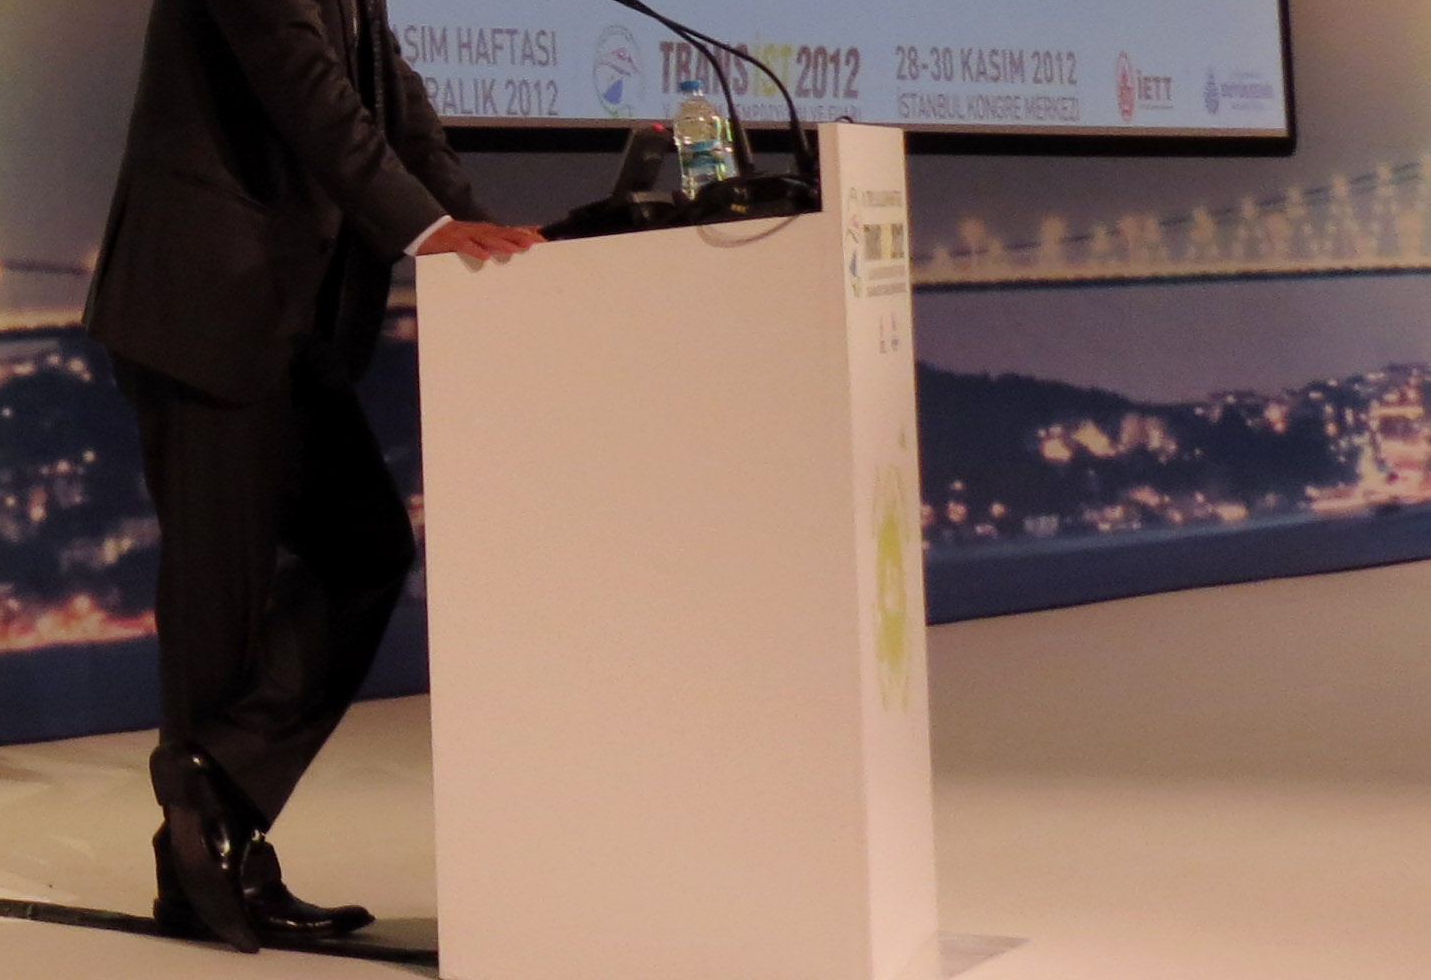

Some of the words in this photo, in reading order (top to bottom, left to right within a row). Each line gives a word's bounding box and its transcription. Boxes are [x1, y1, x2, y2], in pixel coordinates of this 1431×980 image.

[457, 26, 558, 67] HAFTASI
[895, 45, 955, 82] 28-30
[961, 48, 1025, 84] KASIM
[1031, 50, 1078, 85] 2012
[505, 79, 559, 116] 2012
